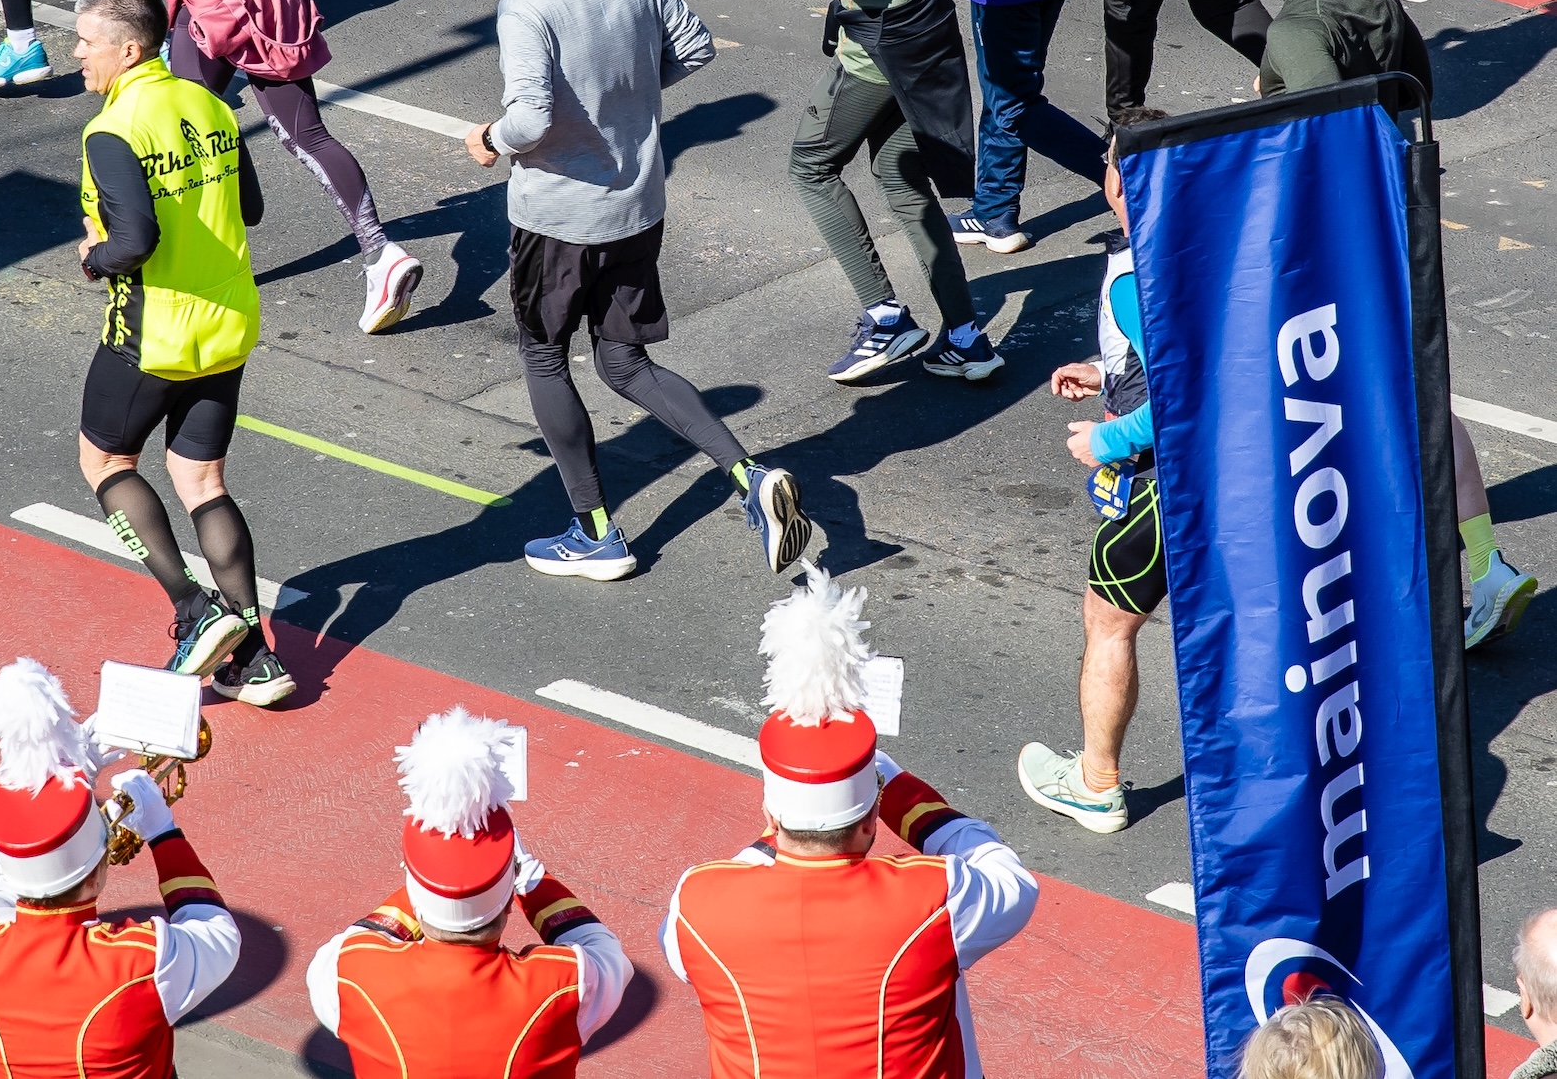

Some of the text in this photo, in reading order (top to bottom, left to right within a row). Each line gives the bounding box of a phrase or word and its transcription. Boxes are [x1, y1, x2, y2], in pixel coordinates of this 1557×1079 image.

[139, 151, 195, 181] Bike
[152, 164, 240, 200] Shop-Racing-Tea
[113, 274, 133, 347] ite.de
[1277, 302, 1371, 901] mainova
